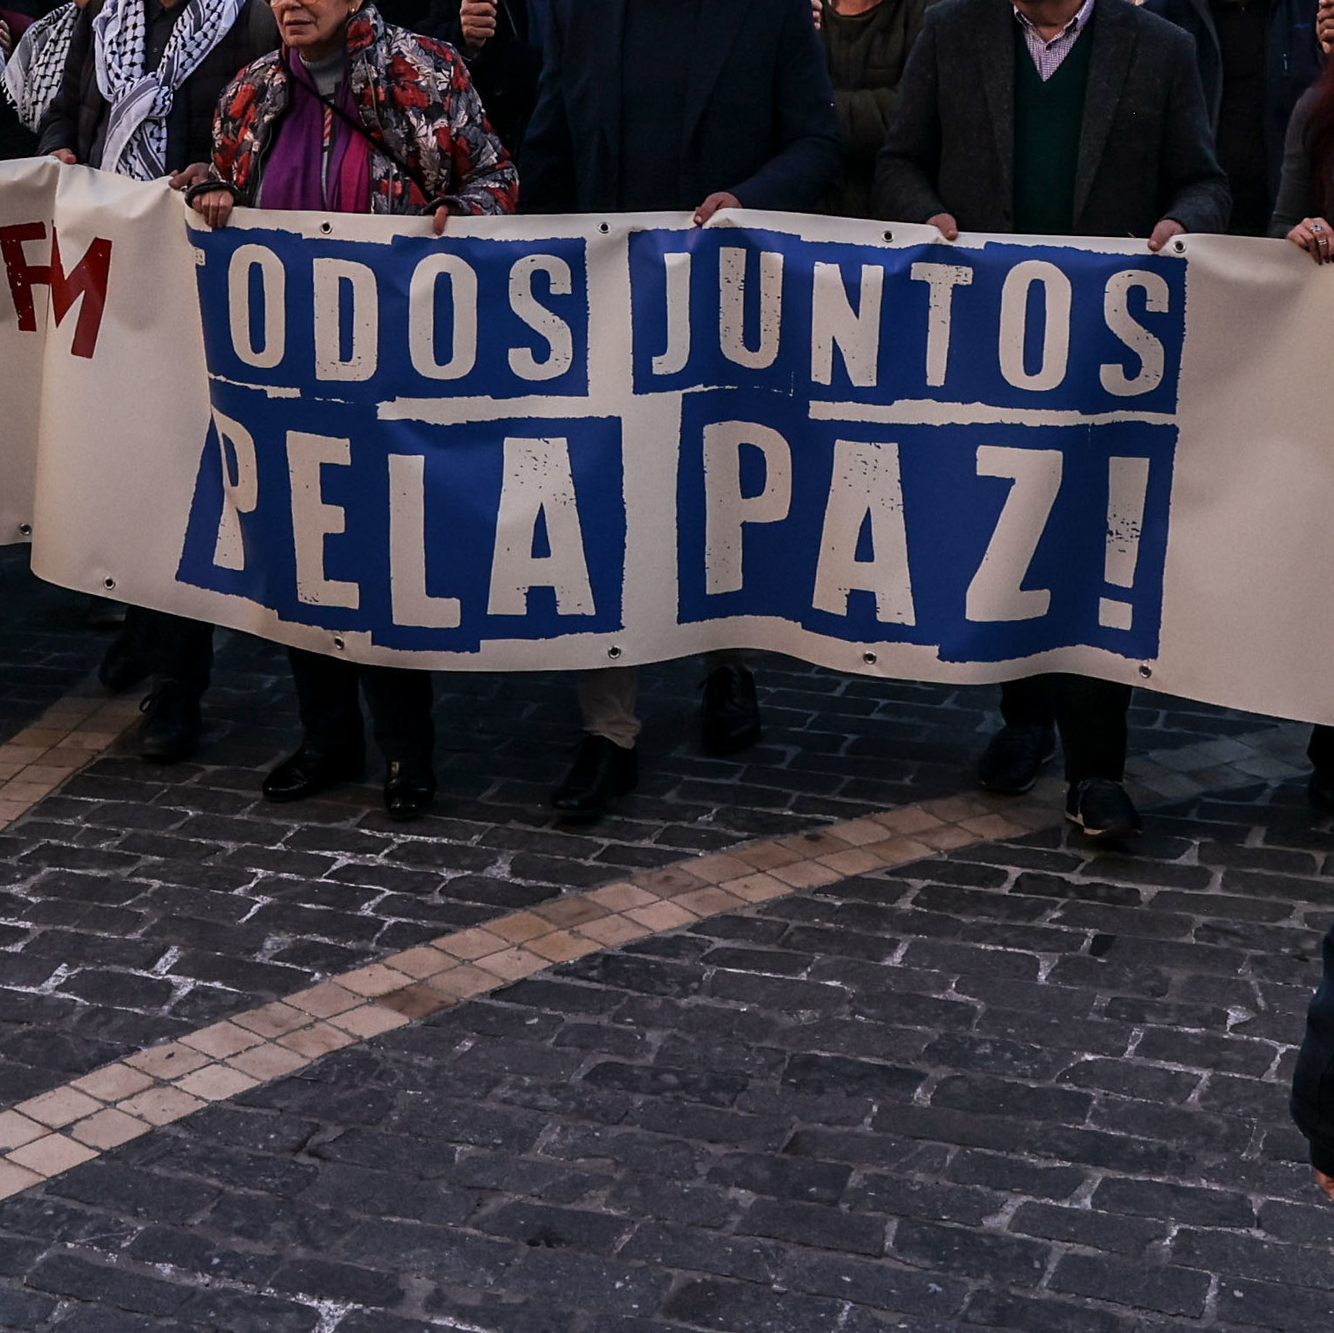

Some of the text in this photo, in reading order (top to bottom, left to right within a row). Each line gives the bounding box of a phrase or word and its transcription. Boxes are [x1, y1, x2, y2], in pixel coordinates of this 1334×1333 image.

[195, 243, 1170, 397] ODOS JUNTOS
[212, 408, 1150, 631] PELA PAZ!
